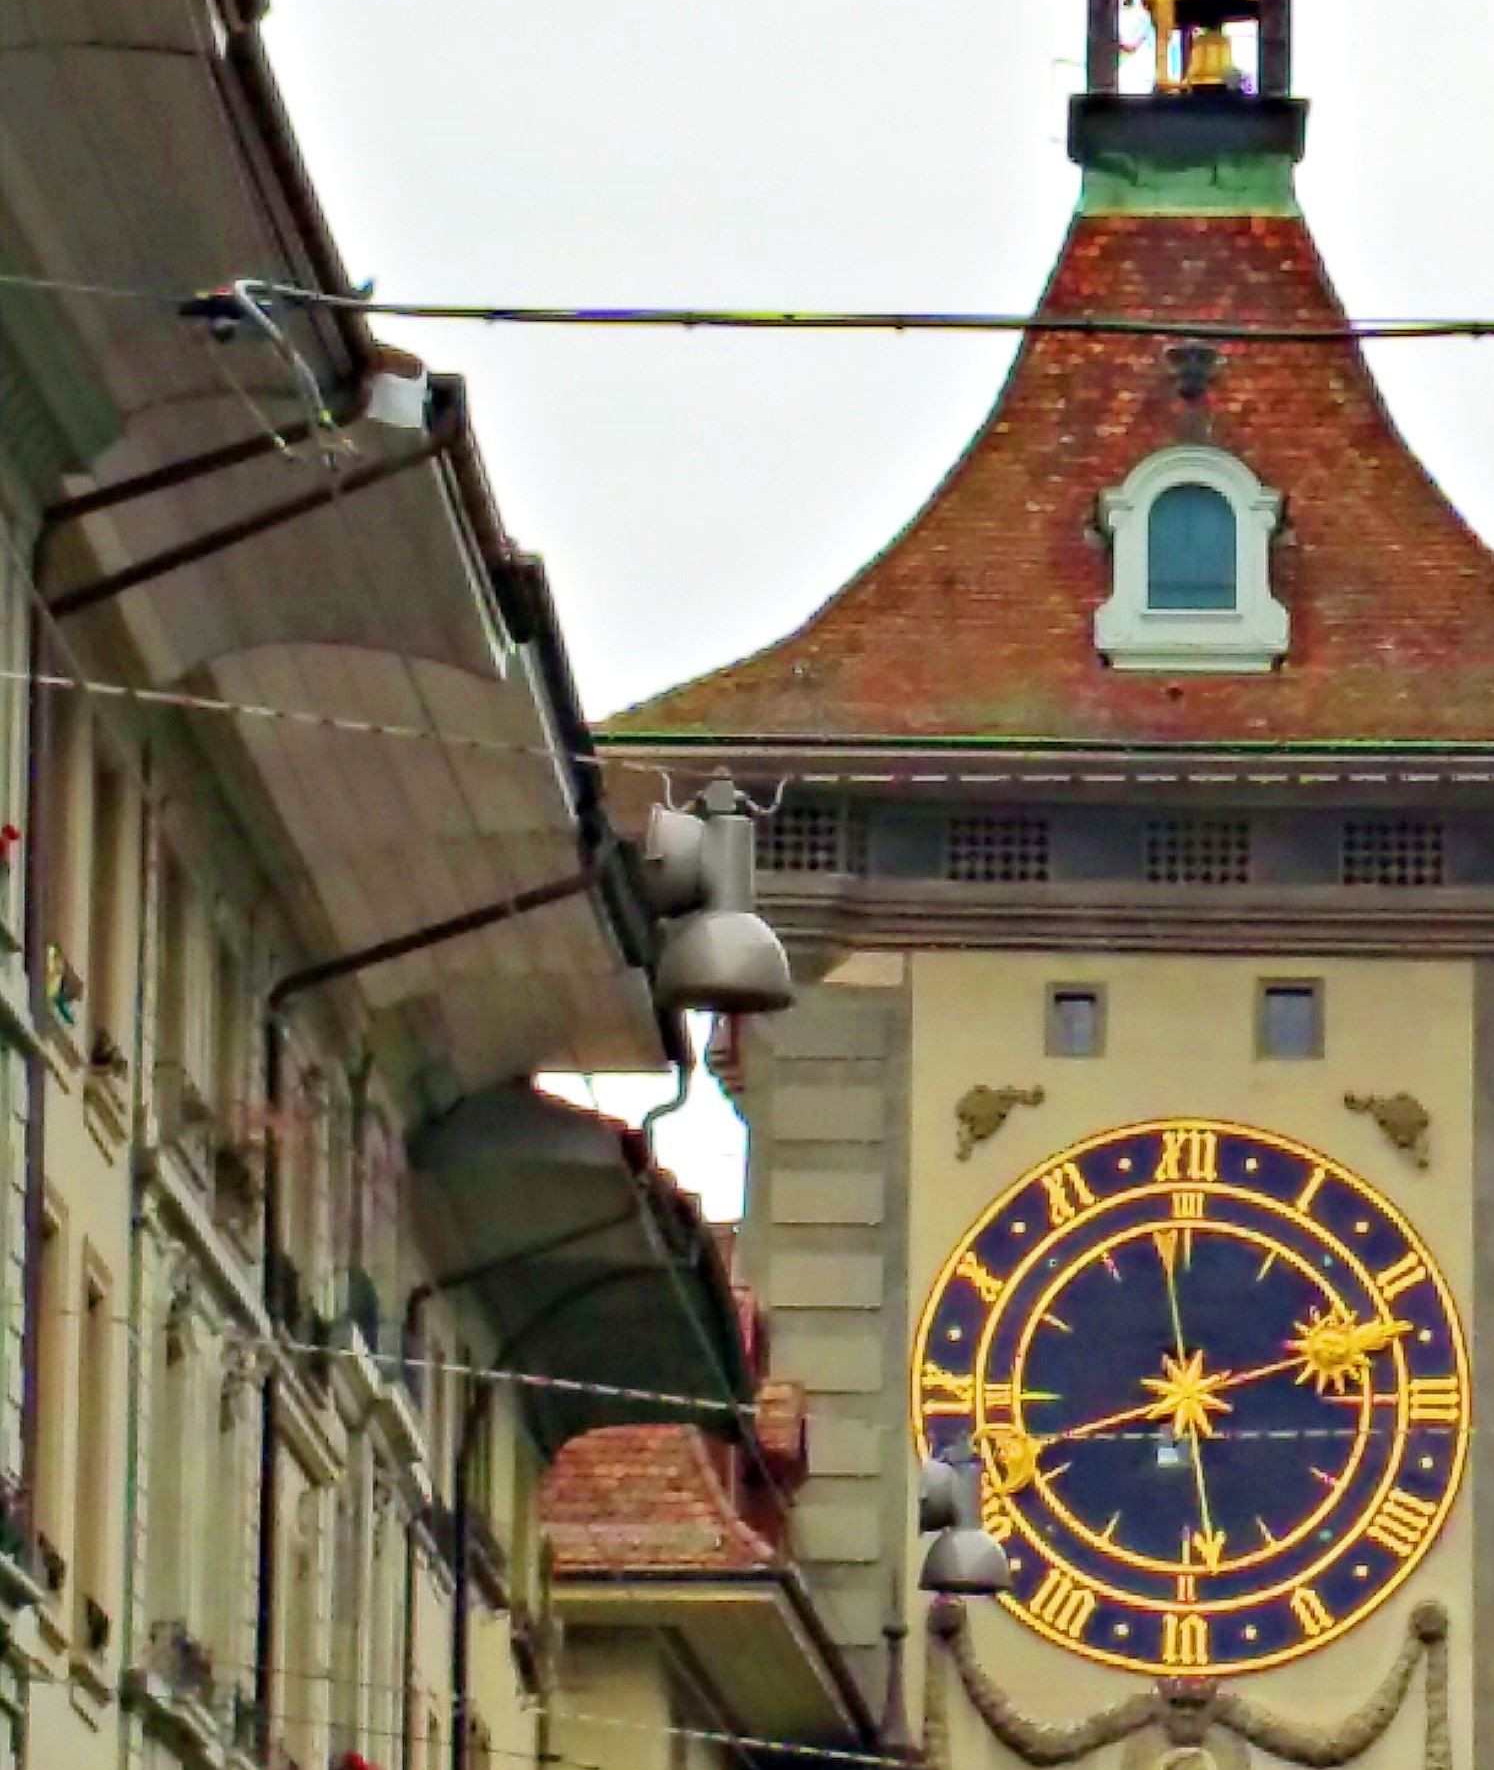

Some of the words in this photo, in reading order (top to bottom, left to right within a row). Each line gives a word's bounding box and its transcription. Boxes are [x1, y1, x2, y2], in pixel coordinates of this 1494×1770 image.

[1155, 1129, 1218, 1182] XII
[1040, 1160, 1096, 1225] XI
[1376, 1251, 1427, 1301] II
[1408, 1375, 1459, 1422] III
